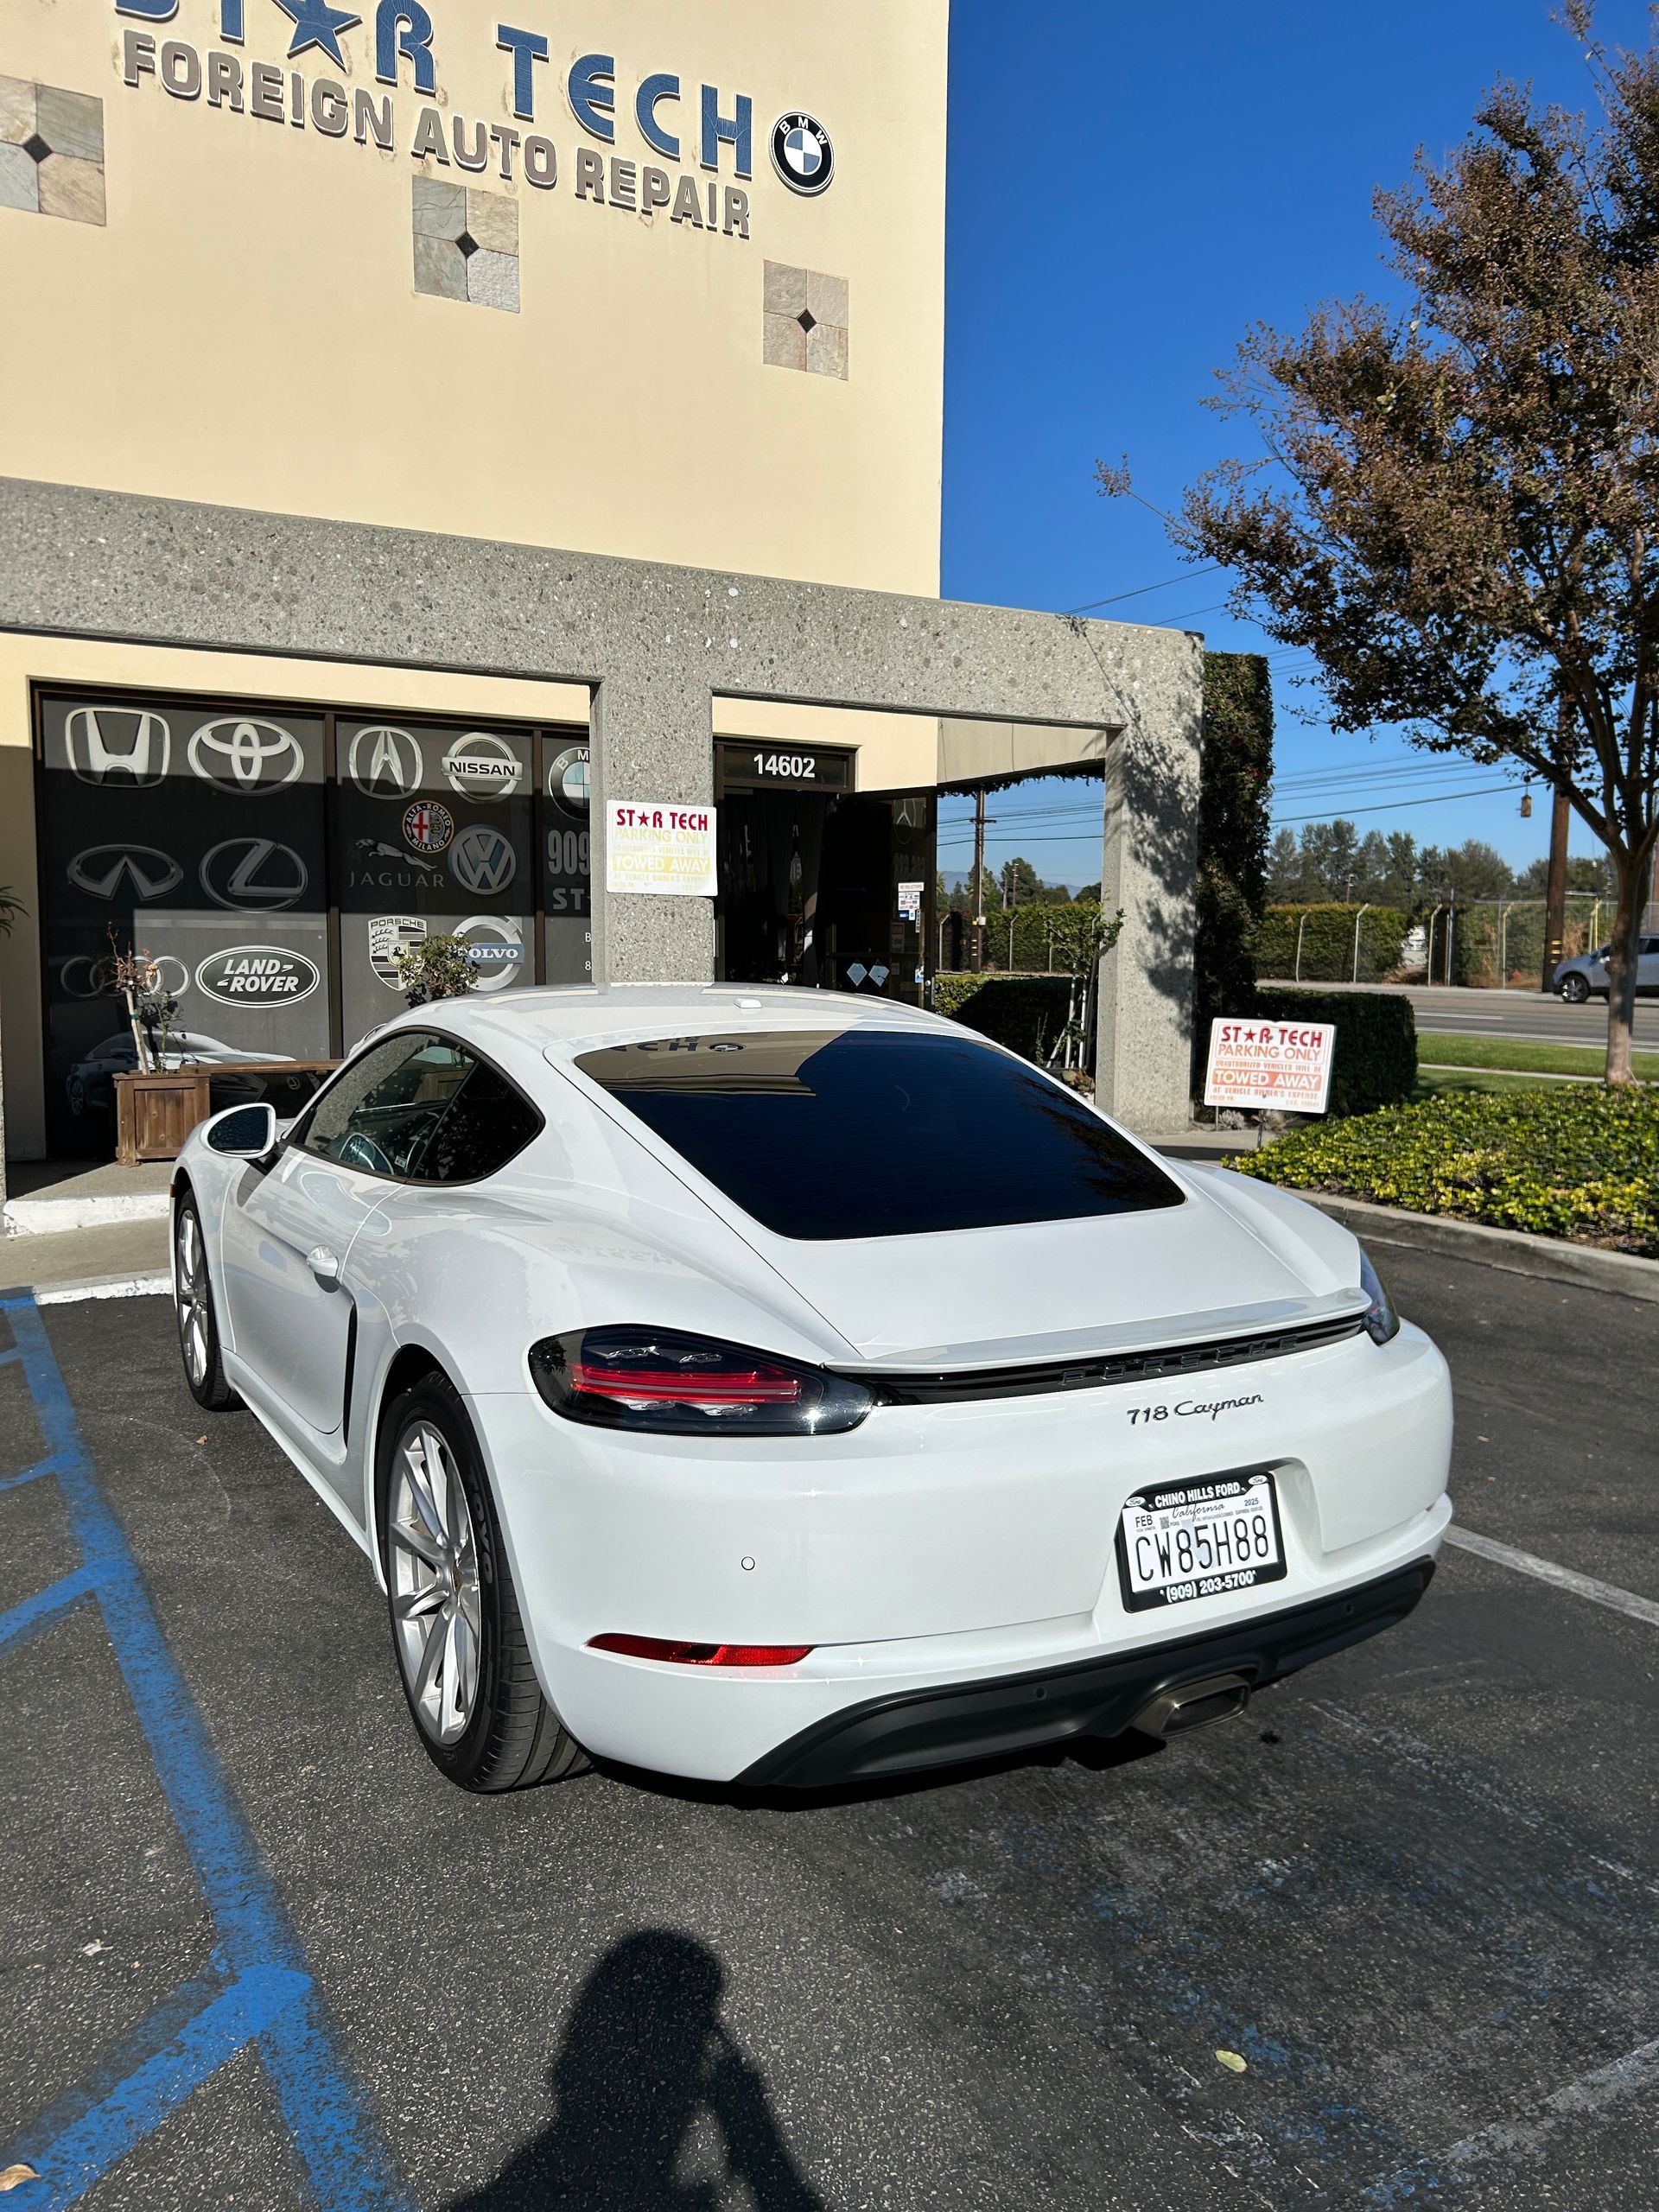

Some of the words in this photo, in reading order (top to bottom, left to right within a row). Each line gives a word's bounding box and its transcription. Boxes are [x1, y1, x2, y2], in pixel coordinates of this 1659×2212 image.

[496, 23, 753, 181] TECH
[123, 29, 394, 152] FOREIGN
[411, 107, 557, 189] AUTO
[575, 147, 751, 239] REPAIR
[779, 116, 828, 145] BMW
[449, 760, 516, 777] NISSAN
[753, 753, 816, 778] 14602
[669, 811, 709, 831] TECH
[411, 838, 445, 850] MILANO
[614, 827, 672, 843] PARKING
[675, 830, 708, 845] ONLY
[614, 855, 665, 872] TOWED
[669, 857, 709, 874] AWAY
[348, 871, 445, 888] JAGUAR
[371, 918, 425, 930] PORSCHE
[465, 947, 519, 960] OLVO
[223, 958, 282, 976] LAND
[228, 976, 299, 993] ROVER
[1278, 1028, 1323, 1048] TECH
[1217, 1043, 1280, 1059] PARKING
[1284, 1047, 1321, 1062] ONLY
[1263, 1062, 1293, 1071] VEHICLES
[1215, 1070, 1269, 1086] TOWED
[1273, 1073, 1320, 1090] AWAY
[1224, 1087, 1251, 1096] VEHICLE
[1288, 1090, 1318, 1100] EXPENSE
[1126, 1405, 1169, 1425] 718
[1173, 1393, 1265, 1421] Cayman
[1154, 1491, 1186, 1509] CHINO
[1186, 1485, 1215, 1502] HILLS
[1215, 1481, 1241, 1497] FORD
[1244, 1497, 1259, 1507] 2025
[1135, 1514, 1154, 1528] FEB
[1172, 1503, 1225, 1522] California
[1135, 1515, 1269, 1581] CW85H88
[1166, 1580, 1198, 1603] (909)
[1198, 1569, 1254, 1595] 203-5700
